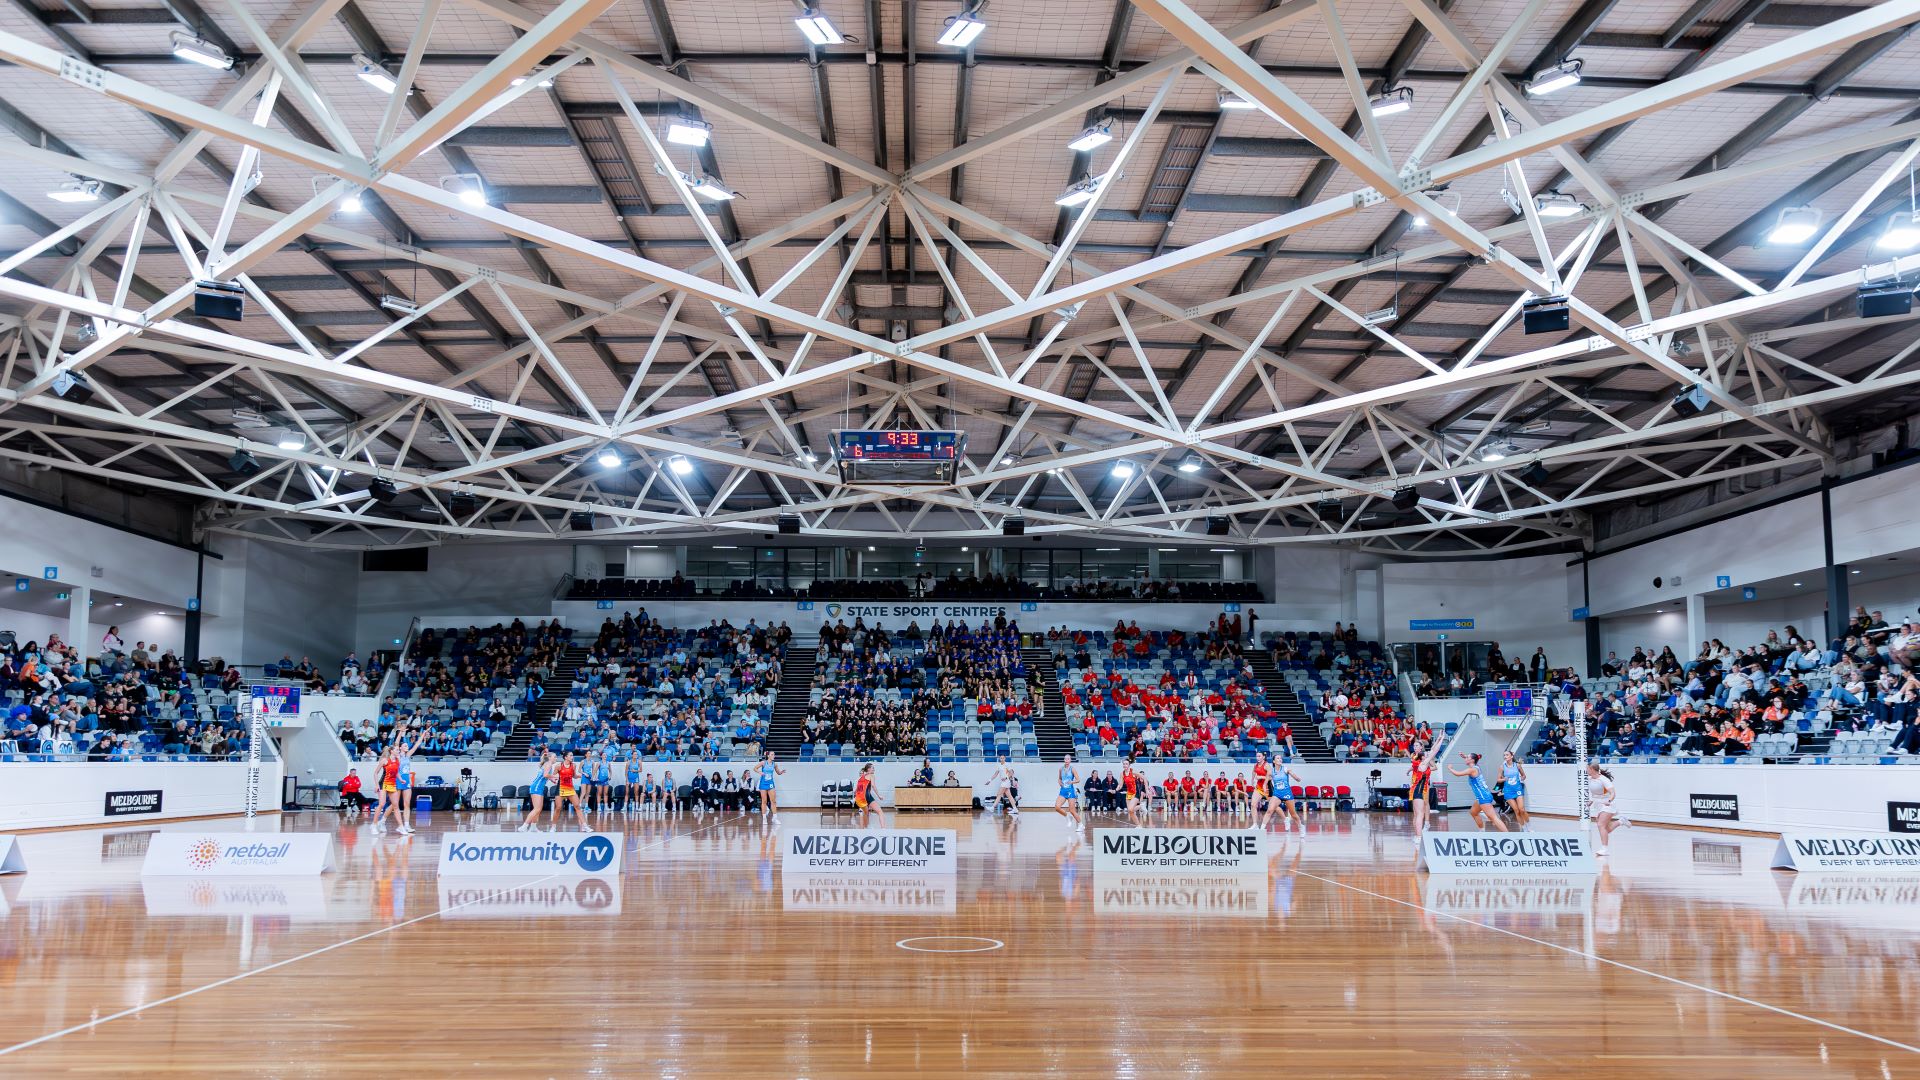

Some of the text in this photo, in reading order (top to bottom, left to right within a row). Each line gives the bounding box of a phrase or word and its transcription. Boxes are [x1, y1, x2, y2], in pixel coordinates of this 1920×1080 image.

[887, 432, 918, 445] 9:33
[945, 446, 954, 458] 7
[847, 606, 1006, 618] STATE SPORT CENTRES
[111, 793, 158, 807] MELBOURNE
[1692, 798, 1737, 811] MELBOURNE
[1896, 807, 1920, 821] ME
[224, 841, 291, 858] netball
[793, 835, 946, 856] MELBOURNE
[1103, 835, 1257, 855] MELBOURNE
[1433, 838, 1583, 857] MELBOURNE
[448, 842, 608, 865] Kommunity TV
[809, 858, 928, 867] EVERY BIT DIFFERENT
[1121, 858, 1240, 867] EVERY BIT DIFFERENT
